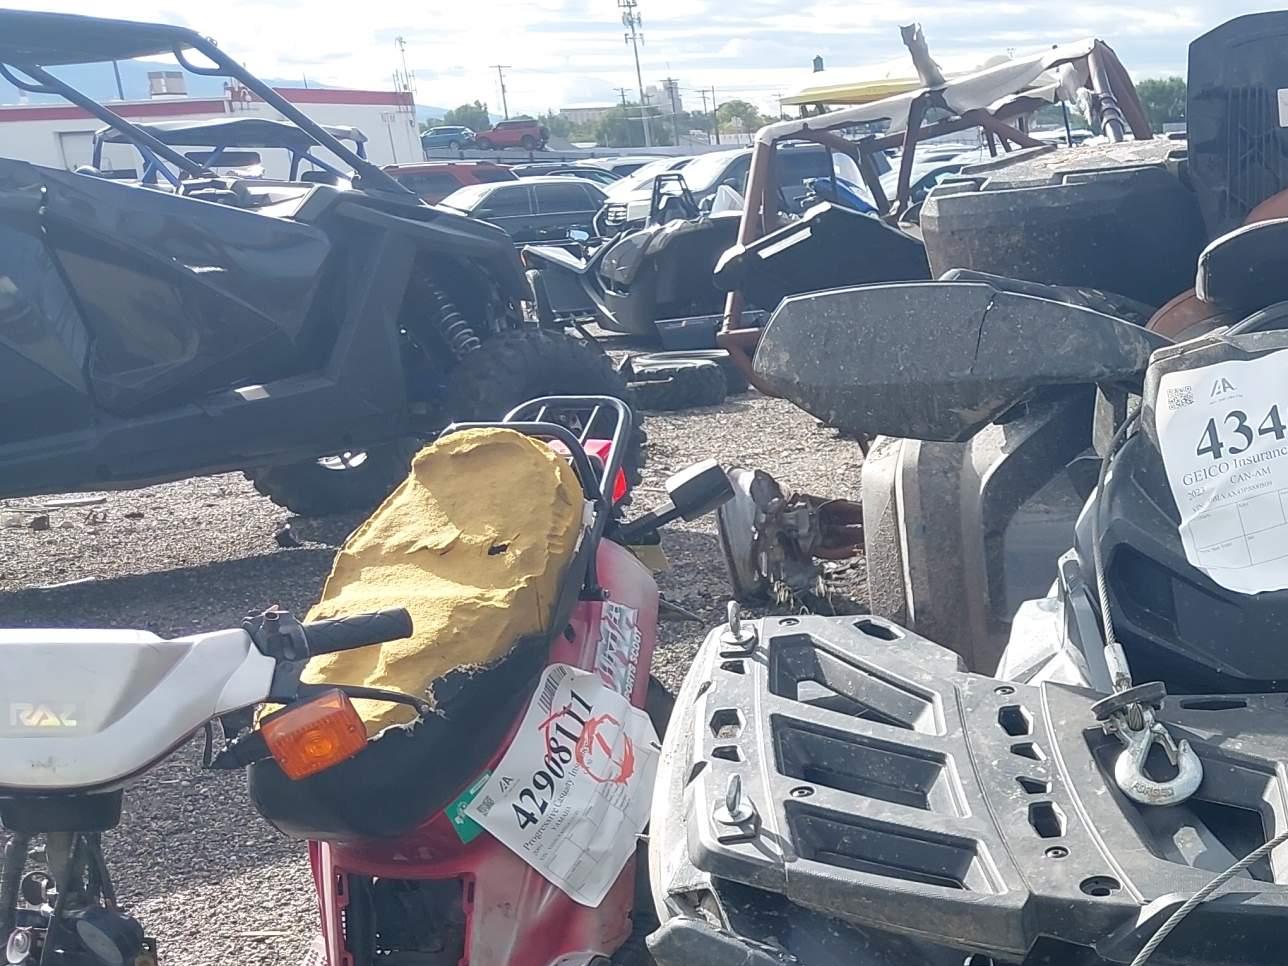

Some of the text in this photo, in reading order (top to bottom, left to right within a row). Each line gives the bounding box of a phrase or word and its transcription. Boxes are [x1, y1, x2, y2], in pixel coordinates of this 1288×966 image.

[1182, 461, 1230, 486] GEICO
[1229, 466, 1272, 486] CAN-AM
[511, 688, 594, 832] 42908111
